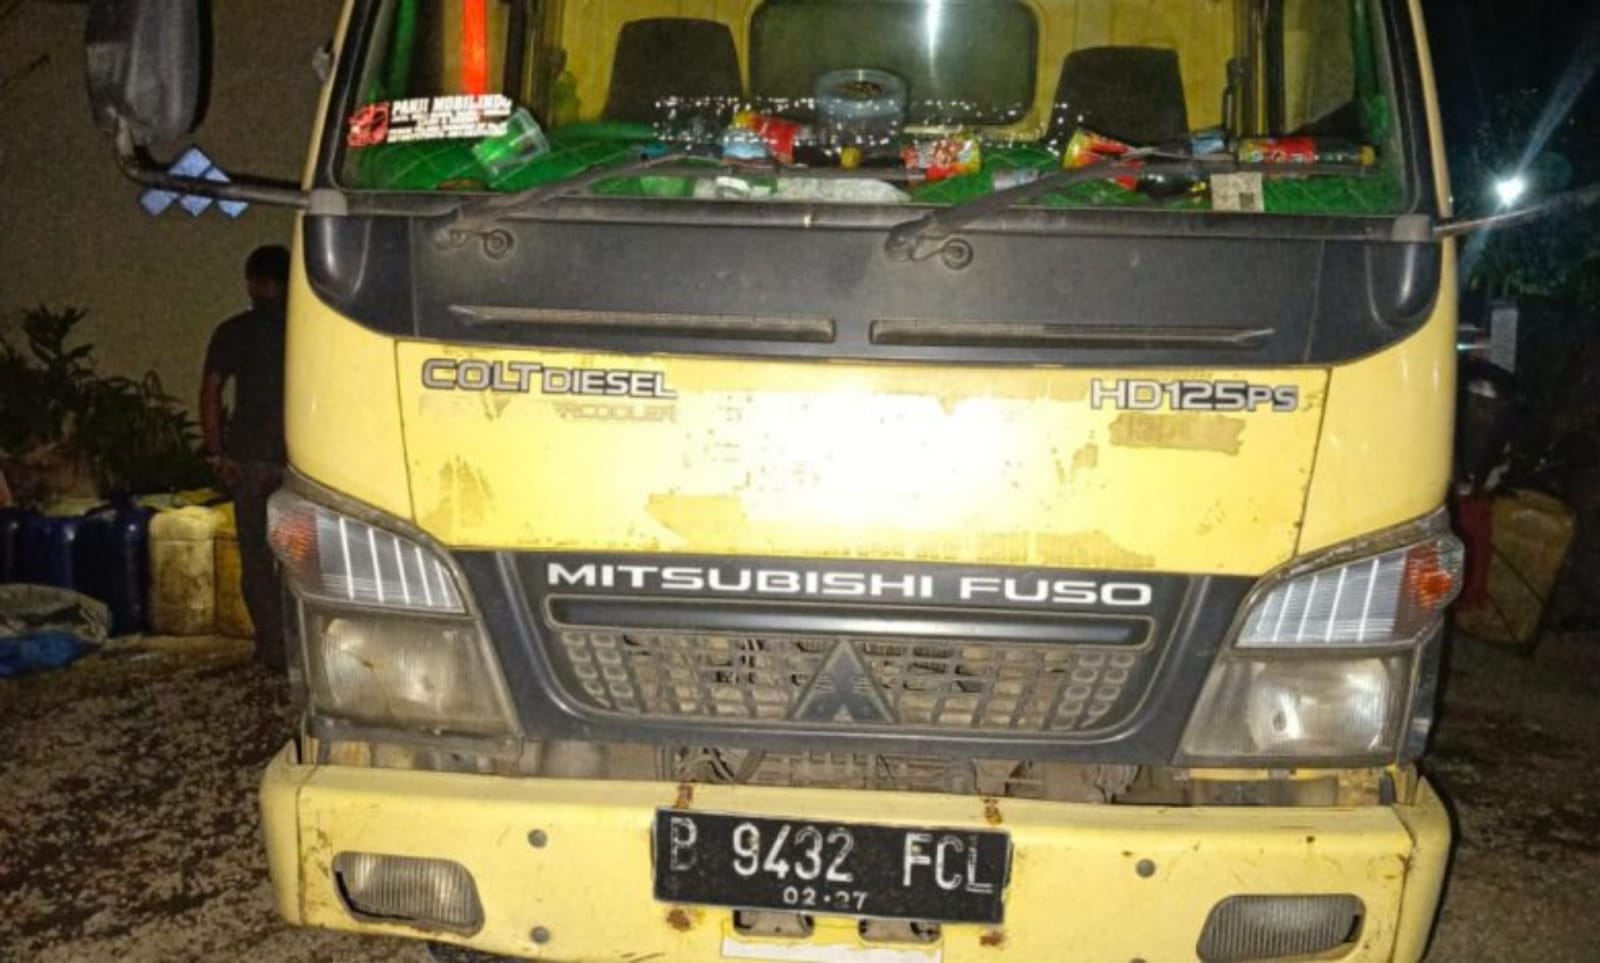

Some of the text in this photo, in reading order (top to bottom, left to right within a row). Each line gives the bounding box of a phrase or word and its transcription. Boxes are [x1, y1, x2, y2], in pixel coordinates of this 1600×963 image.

[422, 358, 679, 399] COLT DIESEL
[548, 563, 1153, 606] MITSUBISHI FUSO
[732, 822, 855, 883] 9432
[902, 832, 994, 895] FCL
